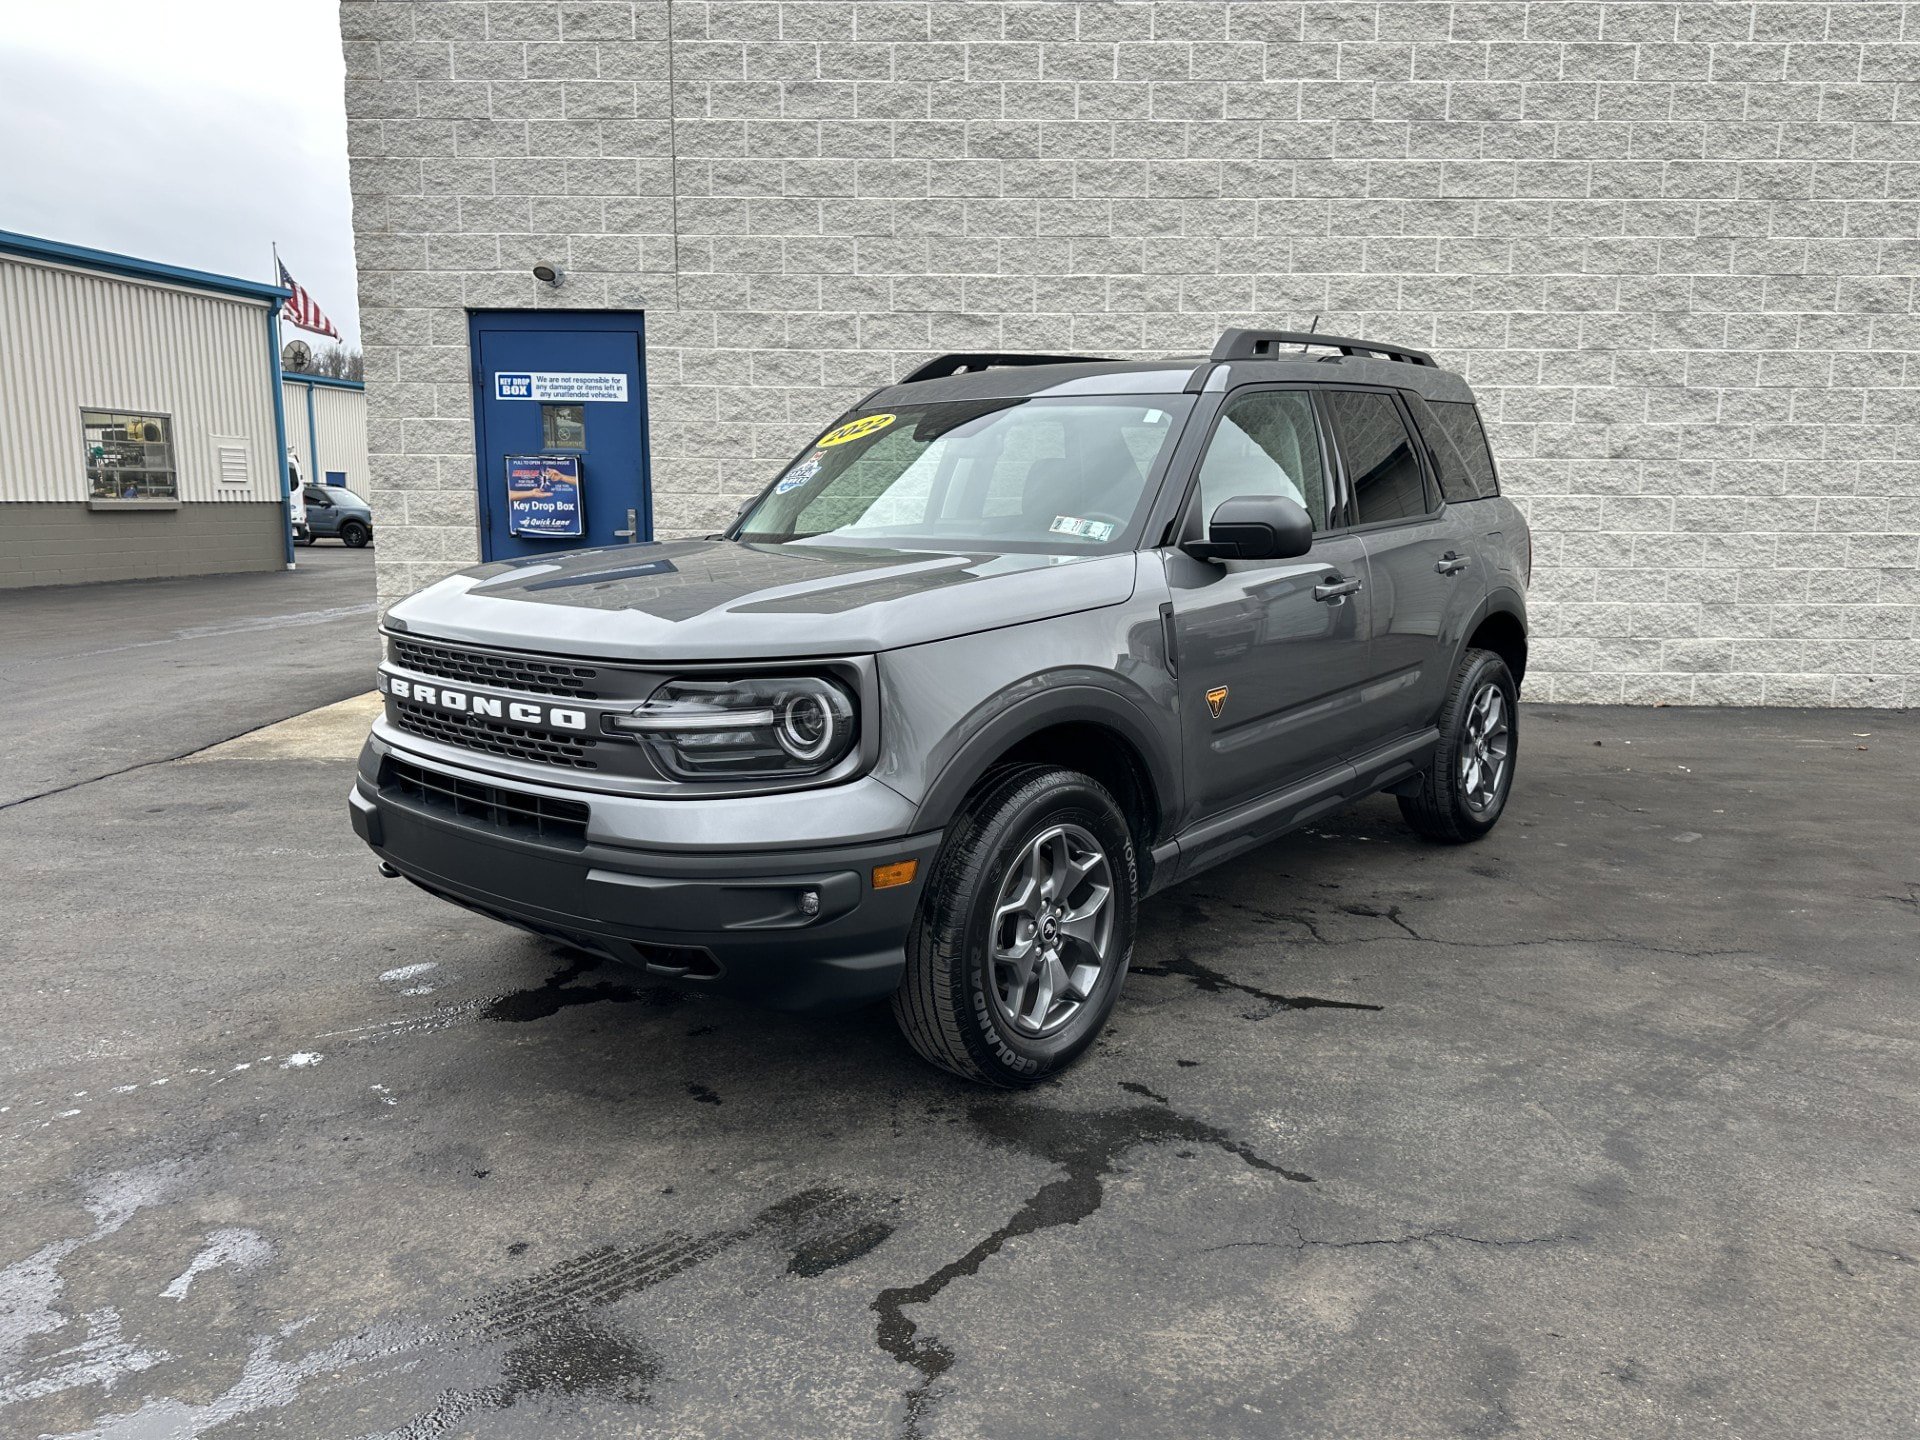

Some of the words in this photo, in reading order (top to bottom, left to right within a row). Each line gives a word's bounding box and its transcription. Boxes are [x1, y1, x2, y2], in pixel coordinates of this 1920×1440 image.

[512, 378, 530, 386] DROP
[573, 376, 610, 385] responsible
[611, 376, 621, 384] for
[502, 385, 528, 395] BOX
[549, 383, 575, 391] damage
[822, 416, 892, 444] 2022
[513, 501, 530, 512] Key
[531, 501, 555, 513] Drop
[556, 501, 575, 511] Box
[530, 517, 551, 526] Quick
[551, 518, 571, 526] Lane
[390, 678, 586, 730] BRONCO
